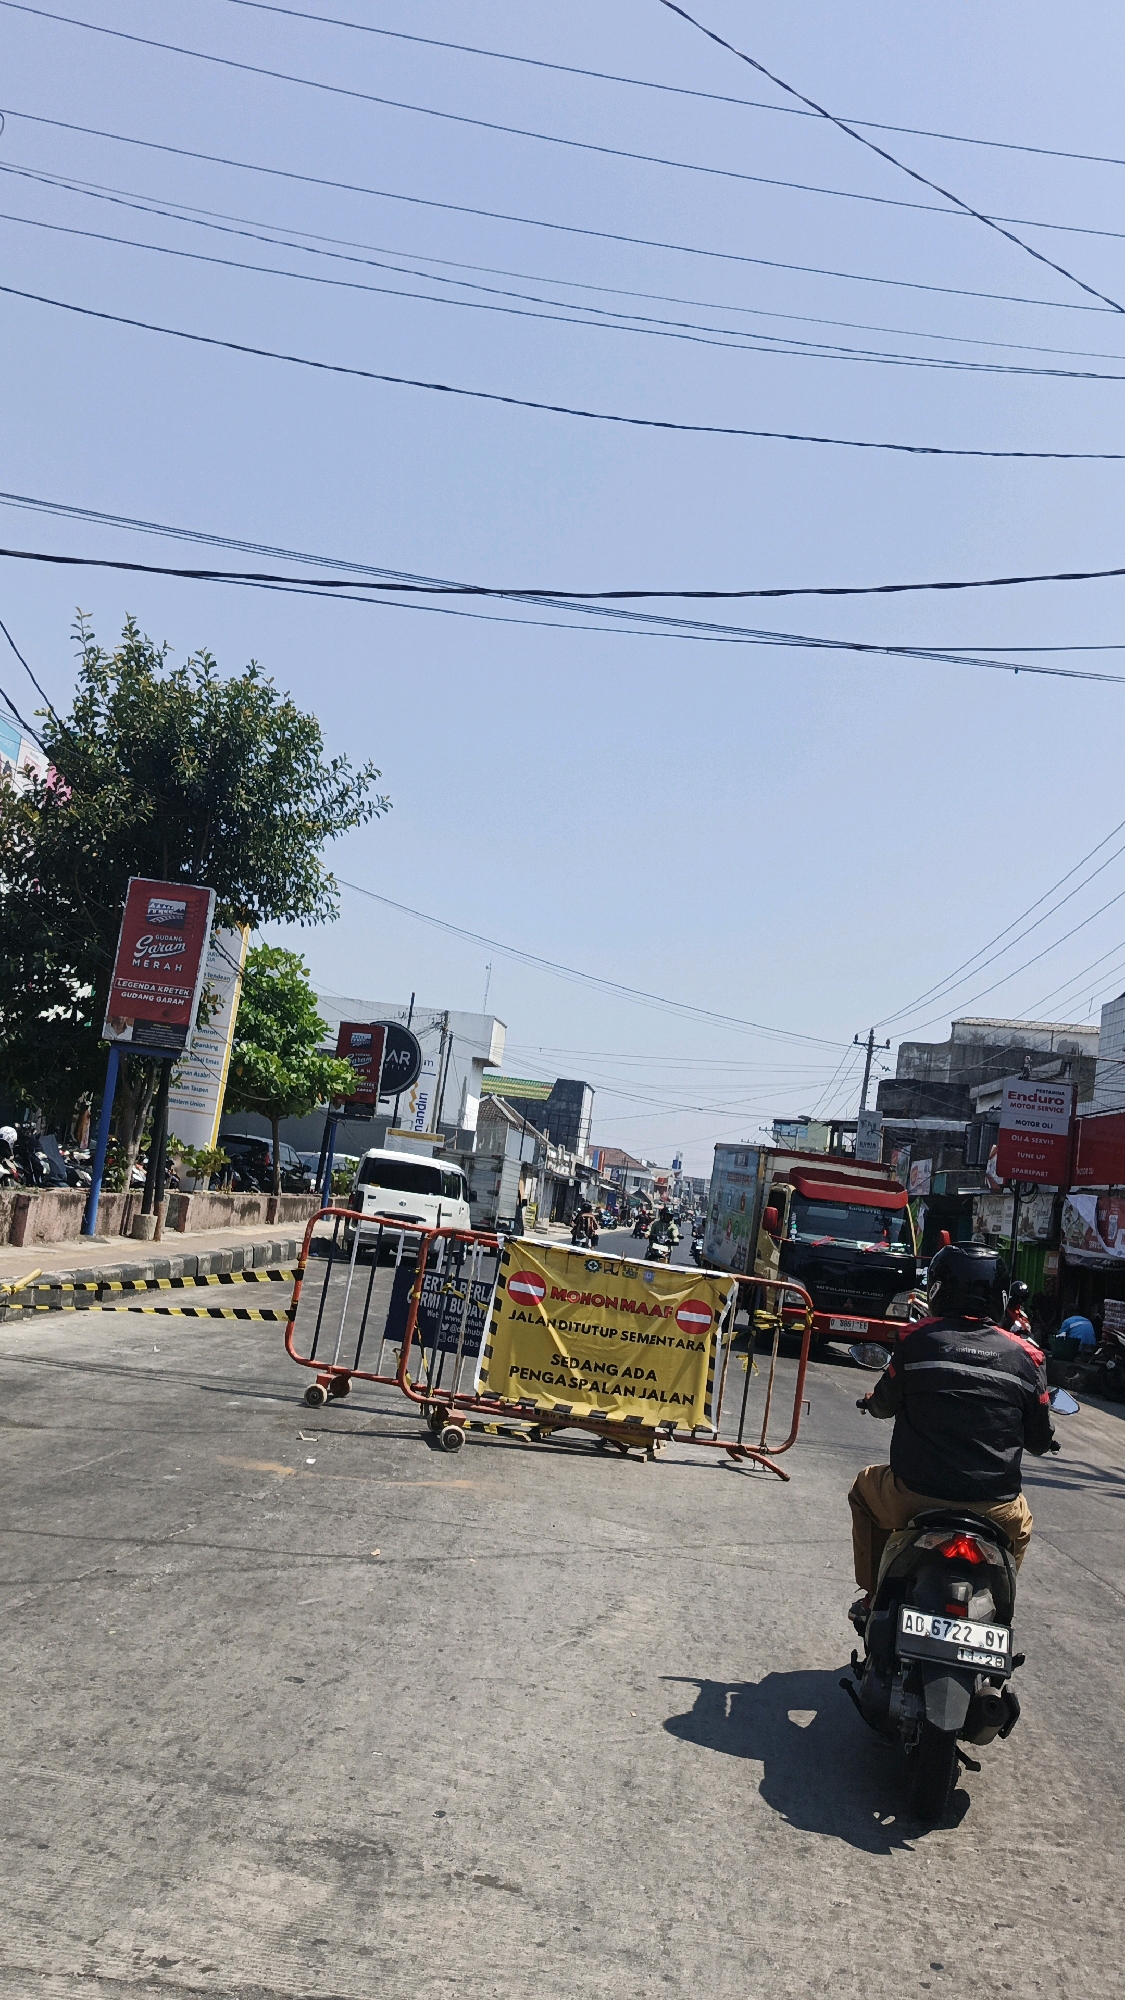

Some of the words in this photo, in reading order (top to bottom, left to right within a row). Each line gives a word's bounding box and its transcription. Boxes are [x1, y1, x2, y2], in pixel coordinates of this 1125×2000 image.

[155, 934, 182, 942] GUDANG
[134, 934, 186, 958] Garam
[132, 959, 183, 971] MERAH
[117, 980, 155, 991] LEGENDA
[157, 986, 190, 996] KRETEK
[121, 992, 155, 1001] GUDANG
[156, 997, 185, 1005] GARAM
[1008, 1091, 1064, 1105] Enduro
[1036, 1106, 1064, 1114] SERVICE
[1032, 1137, 1054, 1145] SERVIS
[1012, 1168, 1048, 1177] SPAREPART
[816, 1285, 860, 1294] MITSUBISHI
[550, 1286, 619, 1310] MOHON
[620, 1298, 674, 1318] MAAF
[508, 1309, 557, 1329] JALAN
[557, 1319, 618, 1339] DITUTUP
[620, 1330, 706, 1352] SEMENTARA
[550, 1353, 619, 1377] SEDANG
[621, 1367, 657, 1381] ADA
[509, 1365, 635, 1397] PENGASPALAN
[636, 1388, 695, 1406] JALAN
[905, 1614, 924, 1632] AD
[931, 1619, 973, 1642] 6722
